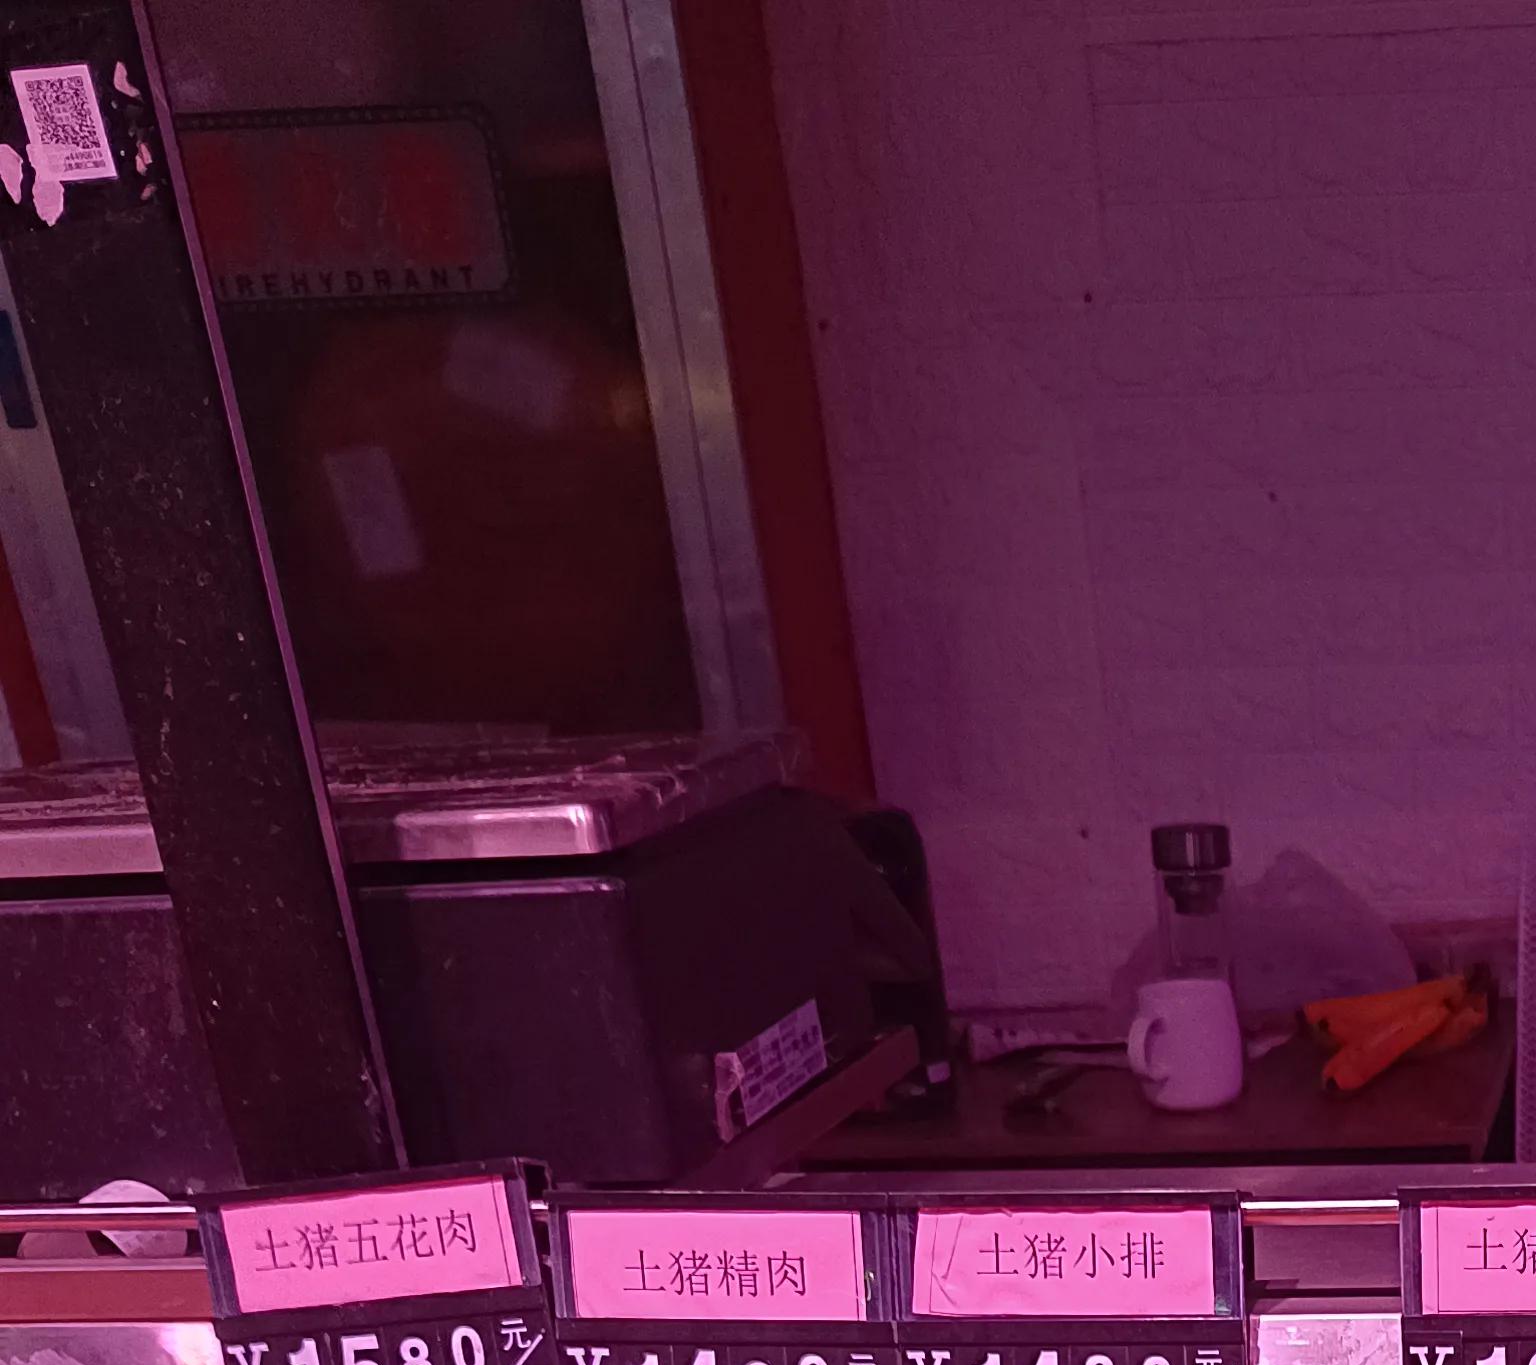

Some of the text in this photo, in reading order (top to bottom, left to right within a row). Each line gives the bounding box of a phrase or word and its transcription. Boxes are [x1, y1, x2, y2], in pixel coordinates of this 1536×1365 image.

[218, 263, 472, 297] IREHYDRANT
[255, 1208, 478, 1273] 土猪五花肉
[976, 1232, 1165, 1281] 土猪小排
[623, 1248, 807, 1297] 土猪精肉
